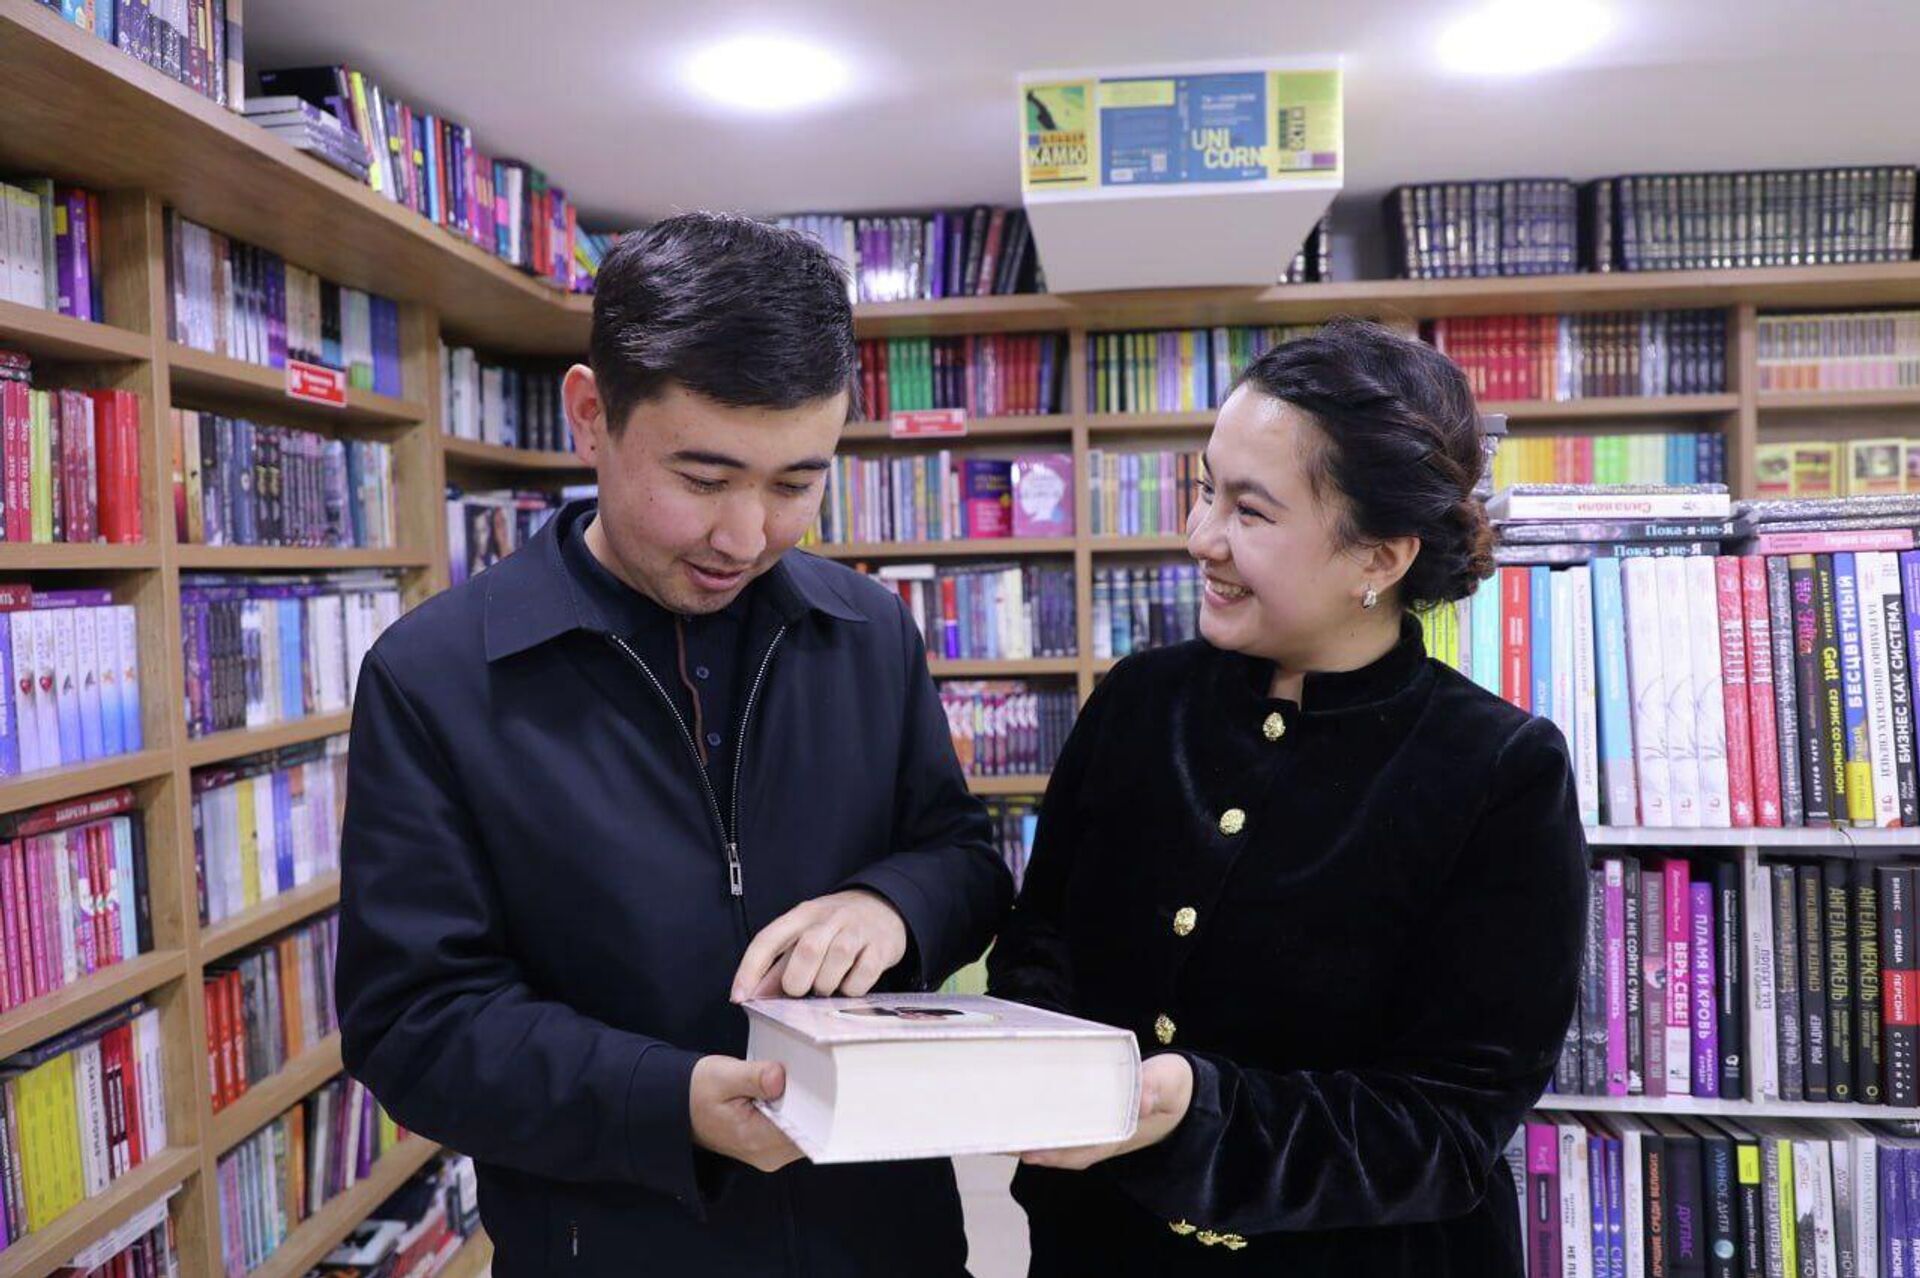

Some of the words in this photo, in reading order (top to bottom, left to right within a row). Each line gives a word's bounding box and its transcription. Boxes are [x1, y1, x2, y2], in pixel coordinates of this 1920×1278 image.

[1029, 145, 1087, 165] КАМЮ
[1192, 128, 1230, 150] UNI
[1204, 147, 1265, 169] CORN
[8, 417, 16, 440] Эго
[9, 481, 17, 511] враг
[21, 481, 30, 511] враг
[1645, 523, 1734, 536] Пока-я-не-Я
[1613, 543, 1701, 557] Пока-я-не-Я
[1750, 618, 1772, 684] NETFLIX
[1836, 575, 1862, 708] БЕСЦВЕТНЫЙ
[1886, 601, 1903, 669] СИСТЕМА
[1823, 647, 1840, 681] Gett
[1868, 619, 1880, 664] ГРАНЬЮ
[1876, 732, 1892, 777] СВЕЧЕЙ
[1893, 673, 1907, 703] КАК
[1828, 689, 1841, 725] СЕРВИС
[1810, 738, 1820, 763] САРА
[1832, 728, 1841, 741] СО
[1896, 705, 1912, 763] БИЗНЕС
[1812, 766, 1823, 802] ФРАЙЕР
[1832, 742, 1845, 794] СМЫСЛОМ
[1626, 898, 1637, 920] КАК
[1892, 877, 1902, 911] БИЗНЕС
[1627, 922, 1638, 936] НЕ
[1829, 887, 1848, 937] АНГЕЛА
[1858, 887, 1877, 937] АНГЕЛА
[1627, 938, 1640, 975] СОЙТИ
[1695, 914, 1710, 968] ПЛАМЯ
[1894, 928, 1903, 963] СЕРДЦА
[1673, 942, 1688, 976] ВЕРЬ
[1806, 942, 1820, 992] СТРАТЕГИЯ
[1830, 941, 1849, 1001] МЕРКЕЛЬ
[1859, 941, 1879, 1001] МЕРКЕЛЬ
[1697, 974, 1710, 984] И
[1627, 988, 1639, 1012] УМА
[1674, 985, 1689, 1025] СЕБЕ!
[1697, 989, 1712, 1039] КРОВЬ
[1809, 1015, 1822, 1043] АДНЕР
[1812, 1044, 1823, 1065] РОН
[1715, 1148, 1729, 1199] ЛУННОЕ
[1768, 1183, 1778, 1212] СЕБЕ
[1651, 1200, 1661, 1233] СРЕДИ
[1677, 1205, 1693, 1259] ДУГЛАС
[1716, 1201, 1730, 1233] ДИТЯ
[1768, 1213, 1780, 1258] МЕШАЙ
[1652, 1235, 1664, 1277] ЛУЧШИЕ
[1771, 1263, 1780, 1278] НЕ
